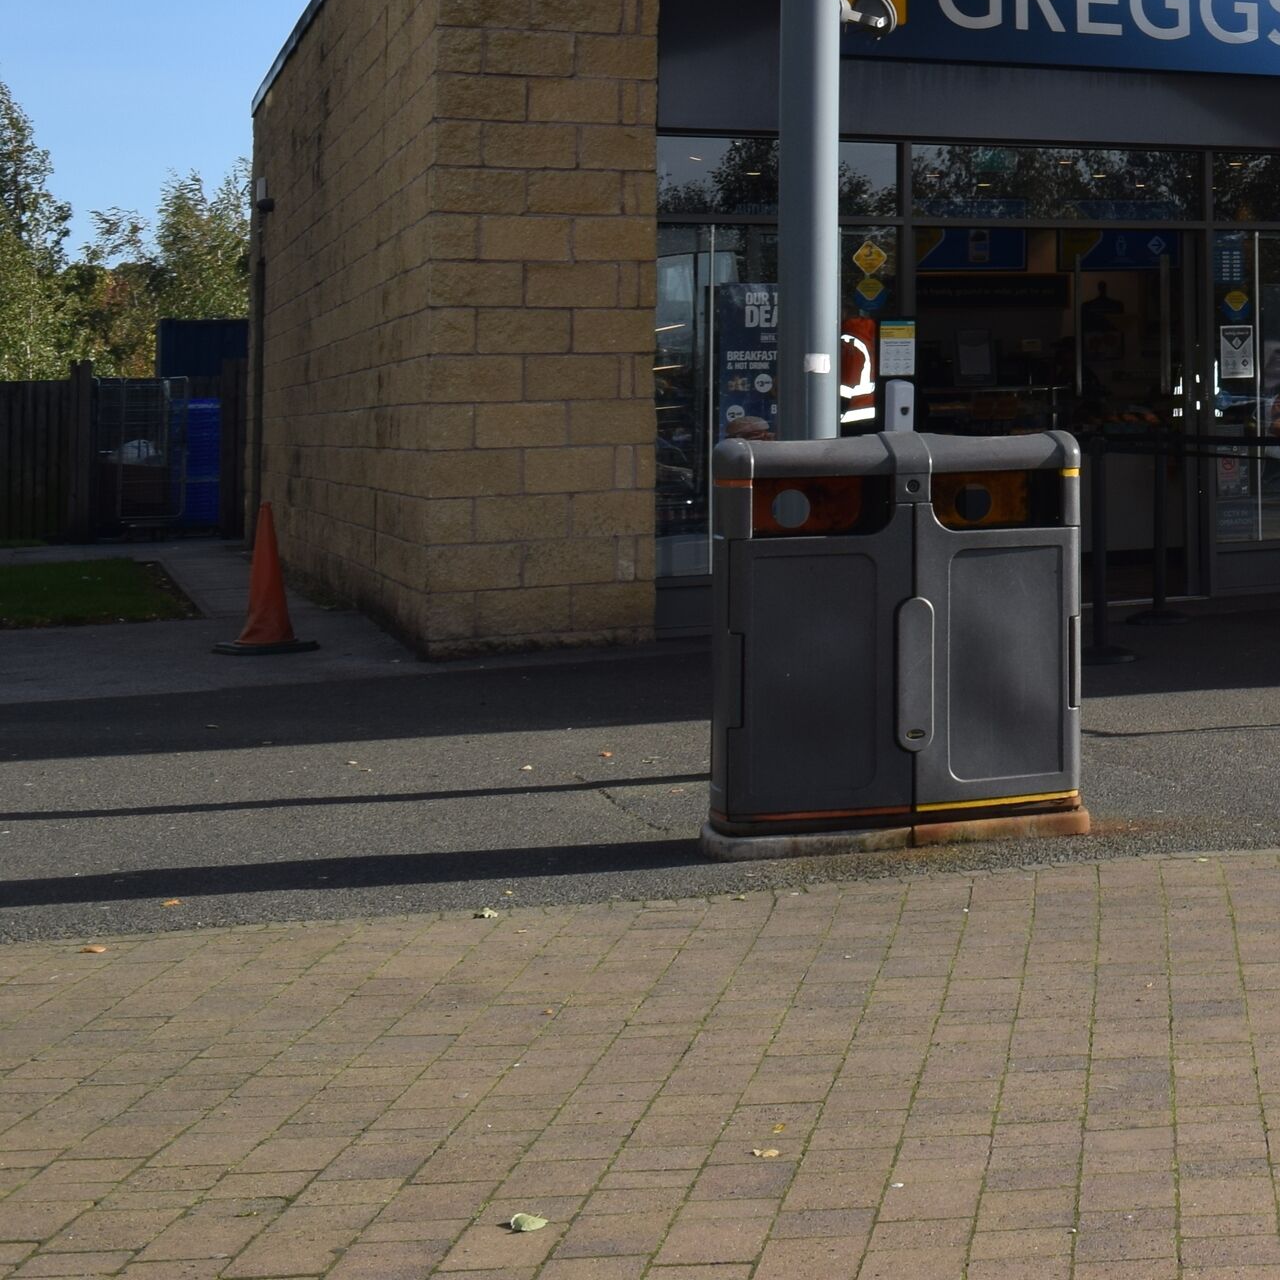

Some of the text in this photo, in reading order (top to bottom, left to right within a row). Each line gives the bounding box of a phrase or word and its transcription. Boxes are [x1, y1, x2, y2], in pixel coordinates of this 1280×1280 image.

[745, 292, 769, 305] OUR
[745, 306, 778, 328] DEA
[726, 350, 778, 360] BREAKFAST
